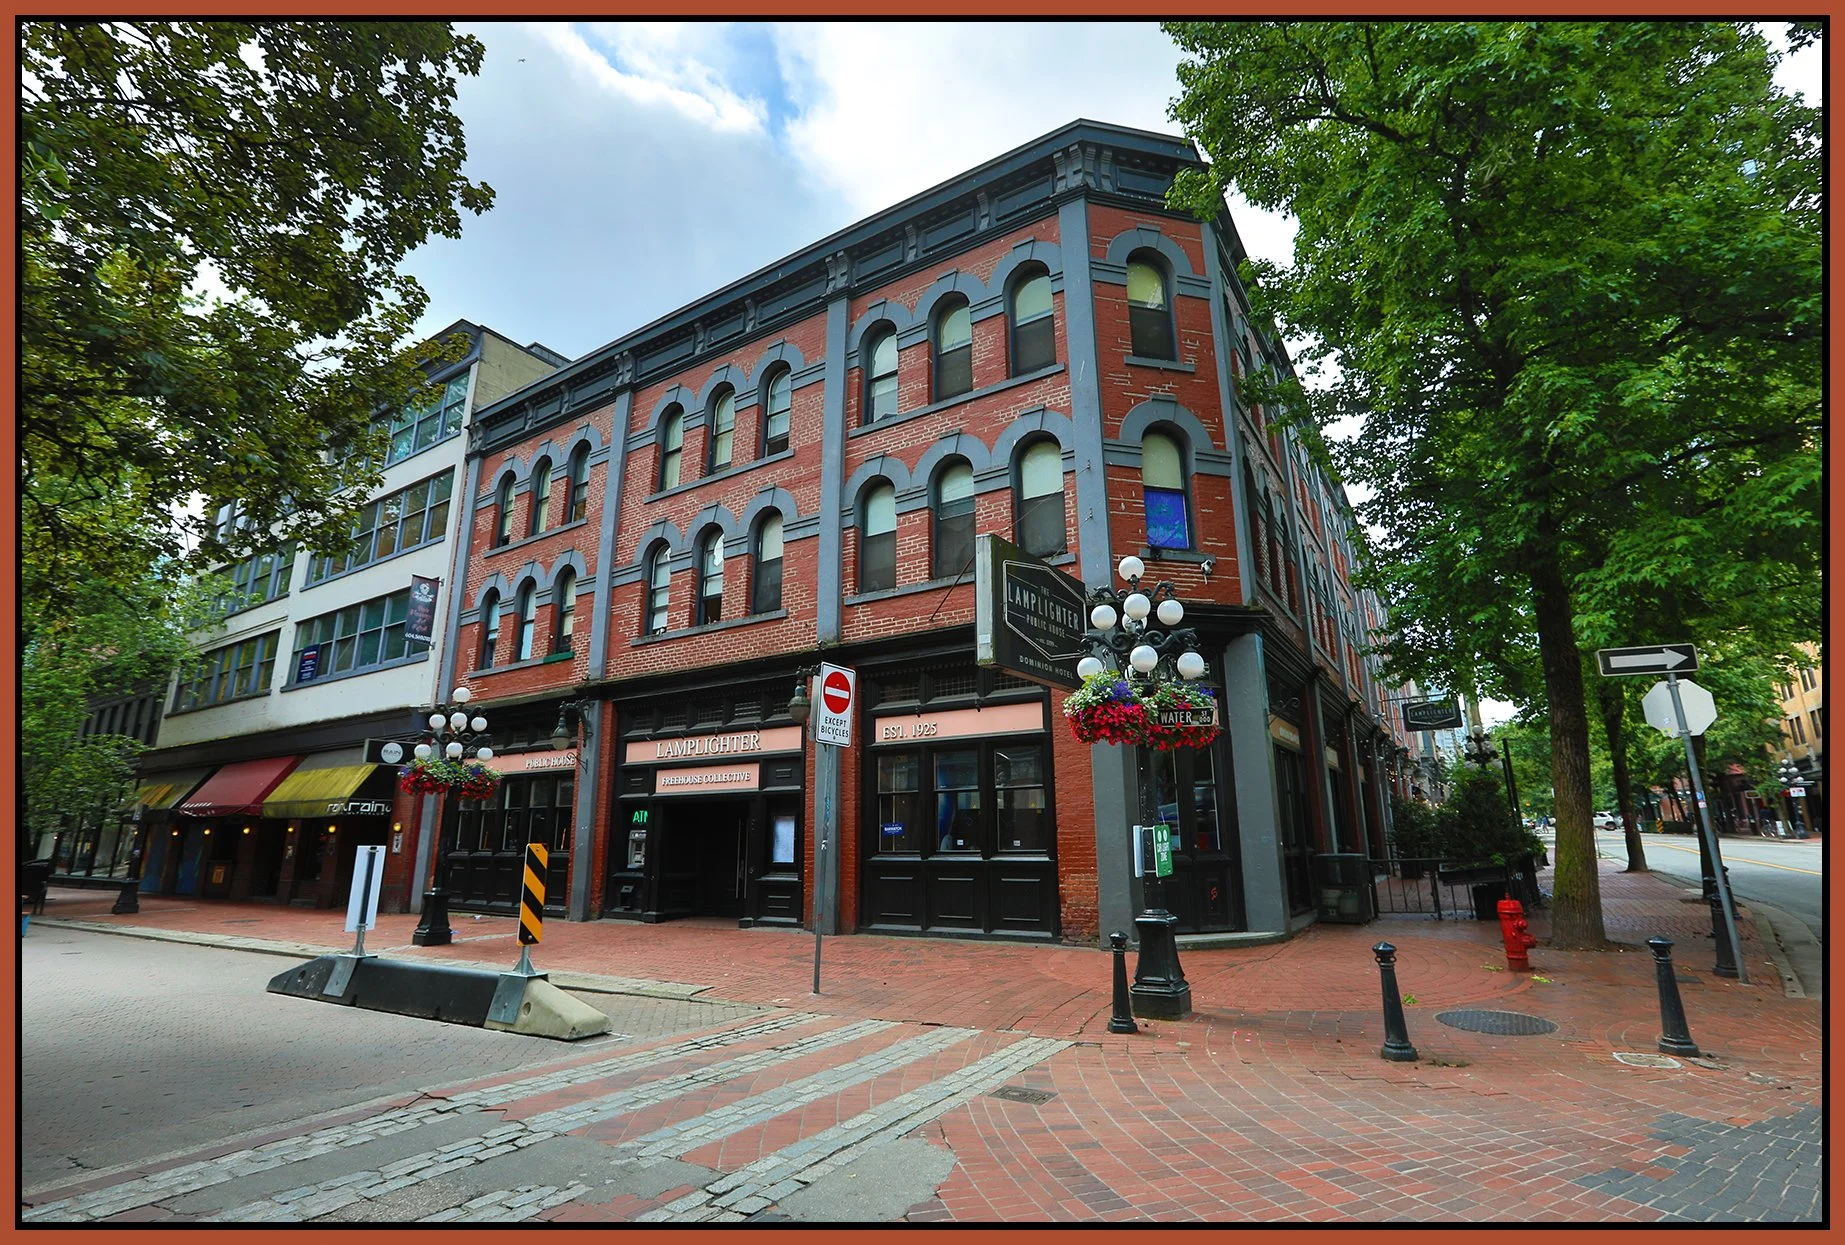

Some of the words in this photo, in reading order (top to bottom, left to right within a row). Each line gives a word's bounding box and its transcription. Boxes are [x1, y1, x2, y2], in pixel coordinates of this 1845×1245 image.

[1040, 585, 1050, 597] THE
[1008, 582, 1079, 631] LAMPLIGHTER
[1026, 614, 1047, 631] PUBLIC
[1048, 624, 1066, 638] HOUSE
[1019, 655, 1053, 672] DOMINION
[1055, 667, 1074, 680] HOTEL
[824, 716, 847, 728] EXCEPT
[1160, 711, 1192, 724] WATER
[820, 725, 849, 738] BICYCLES
[882, 724, 908, 739] EST.
[911, 722, 938, 737] 1925
[656, 732, 761, 758] LAMPLIGHTER
[526, 757, 550, 769] PUBLIC
[551, 753, 576, 767] HOUSE
[661, 774, 703, 787] FREEHOUSE
[703, 771, 751, 785] COLLECTIVE
[348, 800, 385, 813] rain
